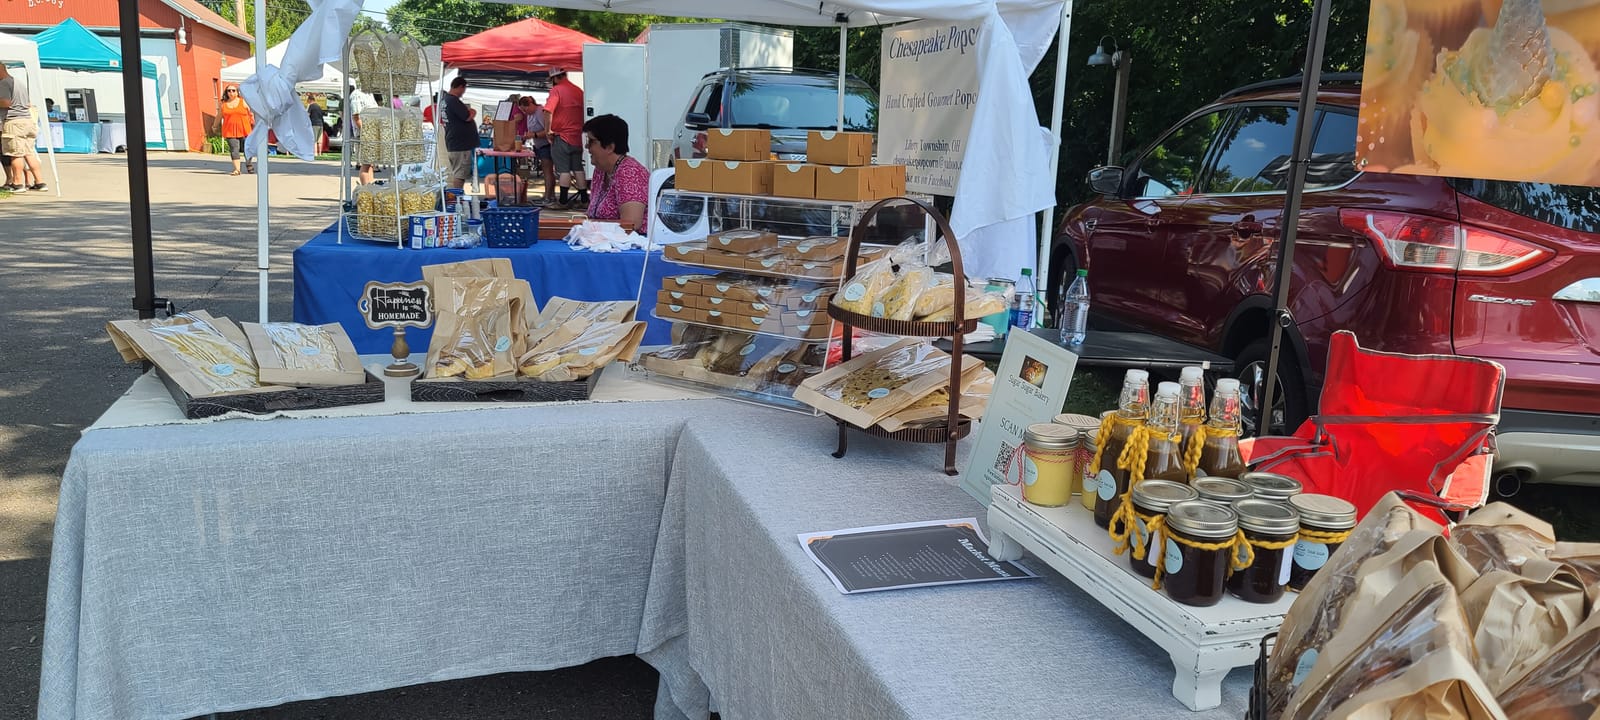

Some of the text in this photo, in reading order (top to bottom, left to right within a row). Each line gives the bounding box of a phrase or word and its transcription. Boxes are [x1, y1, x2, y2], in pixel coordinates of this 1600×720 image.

[889, 30, 946, 61] Chesapeake
[885, 93, 901, 110] Hand
[902, 91, 926, 112] Crafted
[954, 89, 979, 110] Popc
[951, 140, 960, 152] OH
[373, 287, 422, 310] Happiness
[1468, 294, 1536, 306] ESCAPE
[378, 312, 421, 320] HOMEMADE
[1008, 373, 1021, 388] Sugar
[1021, 380, 1034, 395] Sugar
[1034, 387, 1049, 406] Bakery
[1000, 416, 1019, 437] SCAN
[958, 538, 990, 561] Market
